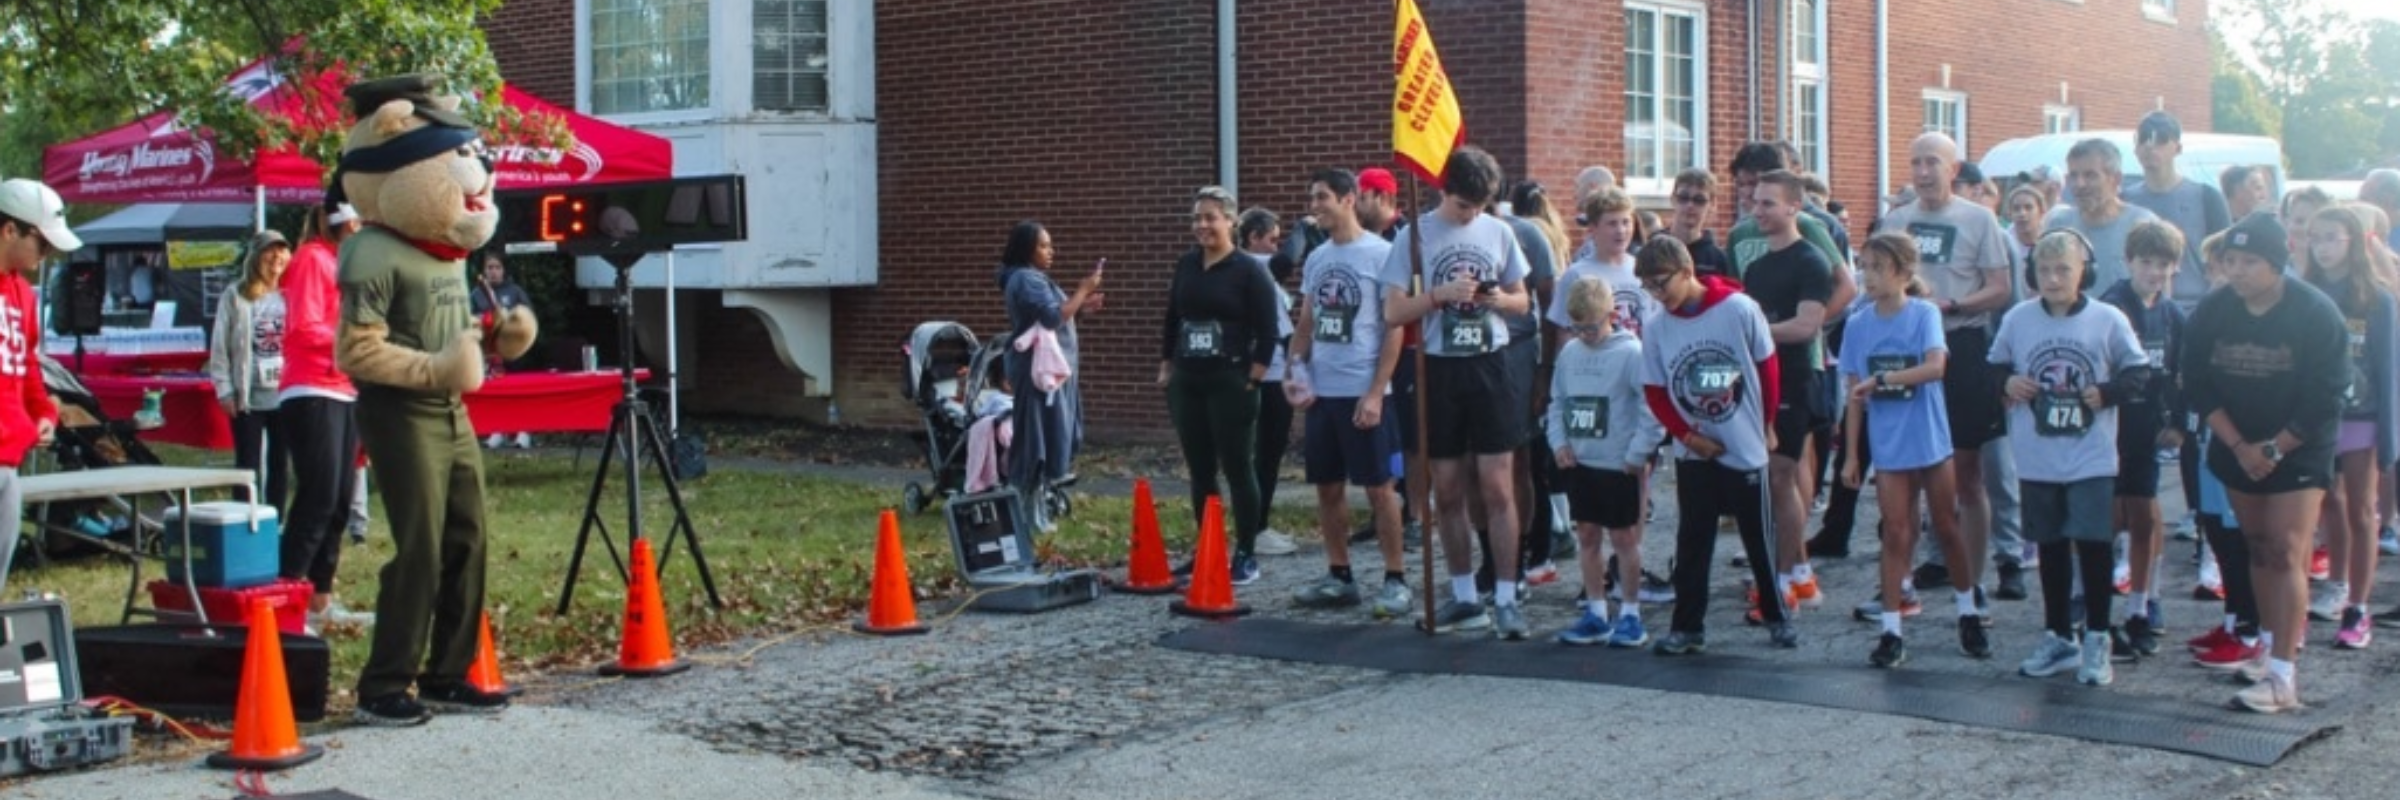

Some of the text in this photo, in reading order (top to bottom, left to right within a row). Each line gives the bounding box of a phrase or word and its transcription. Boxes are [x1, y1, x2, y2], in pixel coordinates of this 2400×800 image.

[129, 142, 191, 173] Marines
[1319, 316, 1343, 335] 703
[1452, 327, 1482, 346] 293
[1699, 371, 1730, 388] 707
[1570, 409, 1595, 429] 701
[2047, 406, 2083, 428] 474
